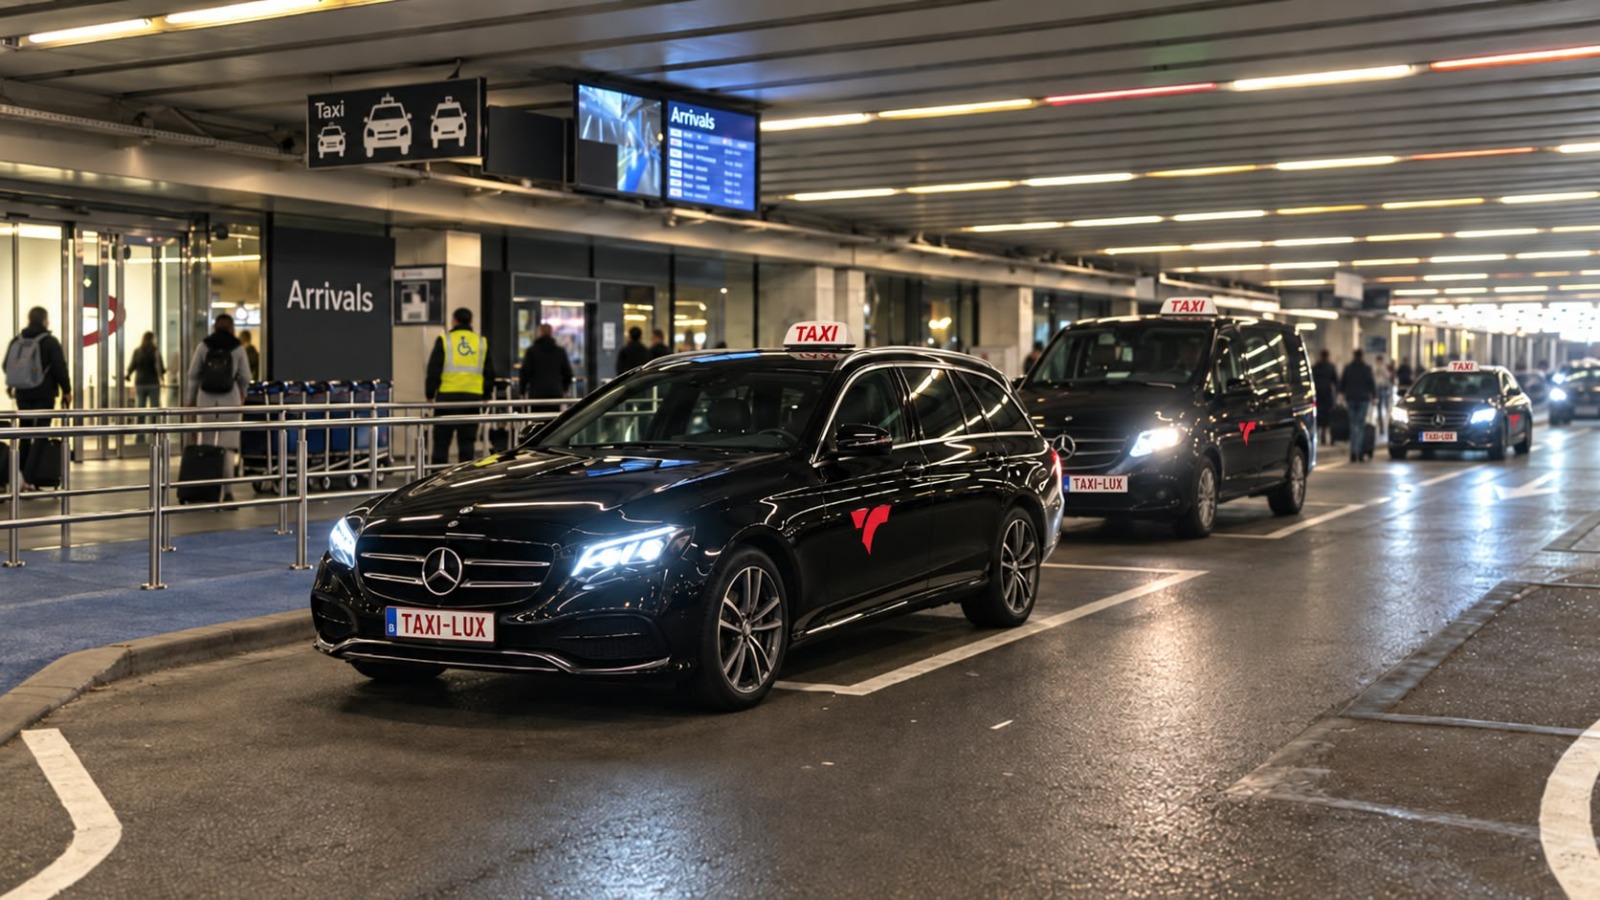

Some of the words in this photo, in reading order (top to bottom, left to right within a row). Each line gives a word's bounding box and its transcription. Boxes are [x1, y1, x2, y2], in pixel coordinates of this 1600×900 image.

[315, 100, 345, 119] Taxi
[671, 106, 715, 130] Arrivals
[287, 279, 374, 313] Arrivals
[1171, 300, 1206, 313] TAXI
[795, 325, 838, 342] TAXI
[1452, 362, 1474, 371] TAXI
[1073, 478, 1123, 490] TAXI-LUX
[401, 613, 486, 638] TAXI-LUX
